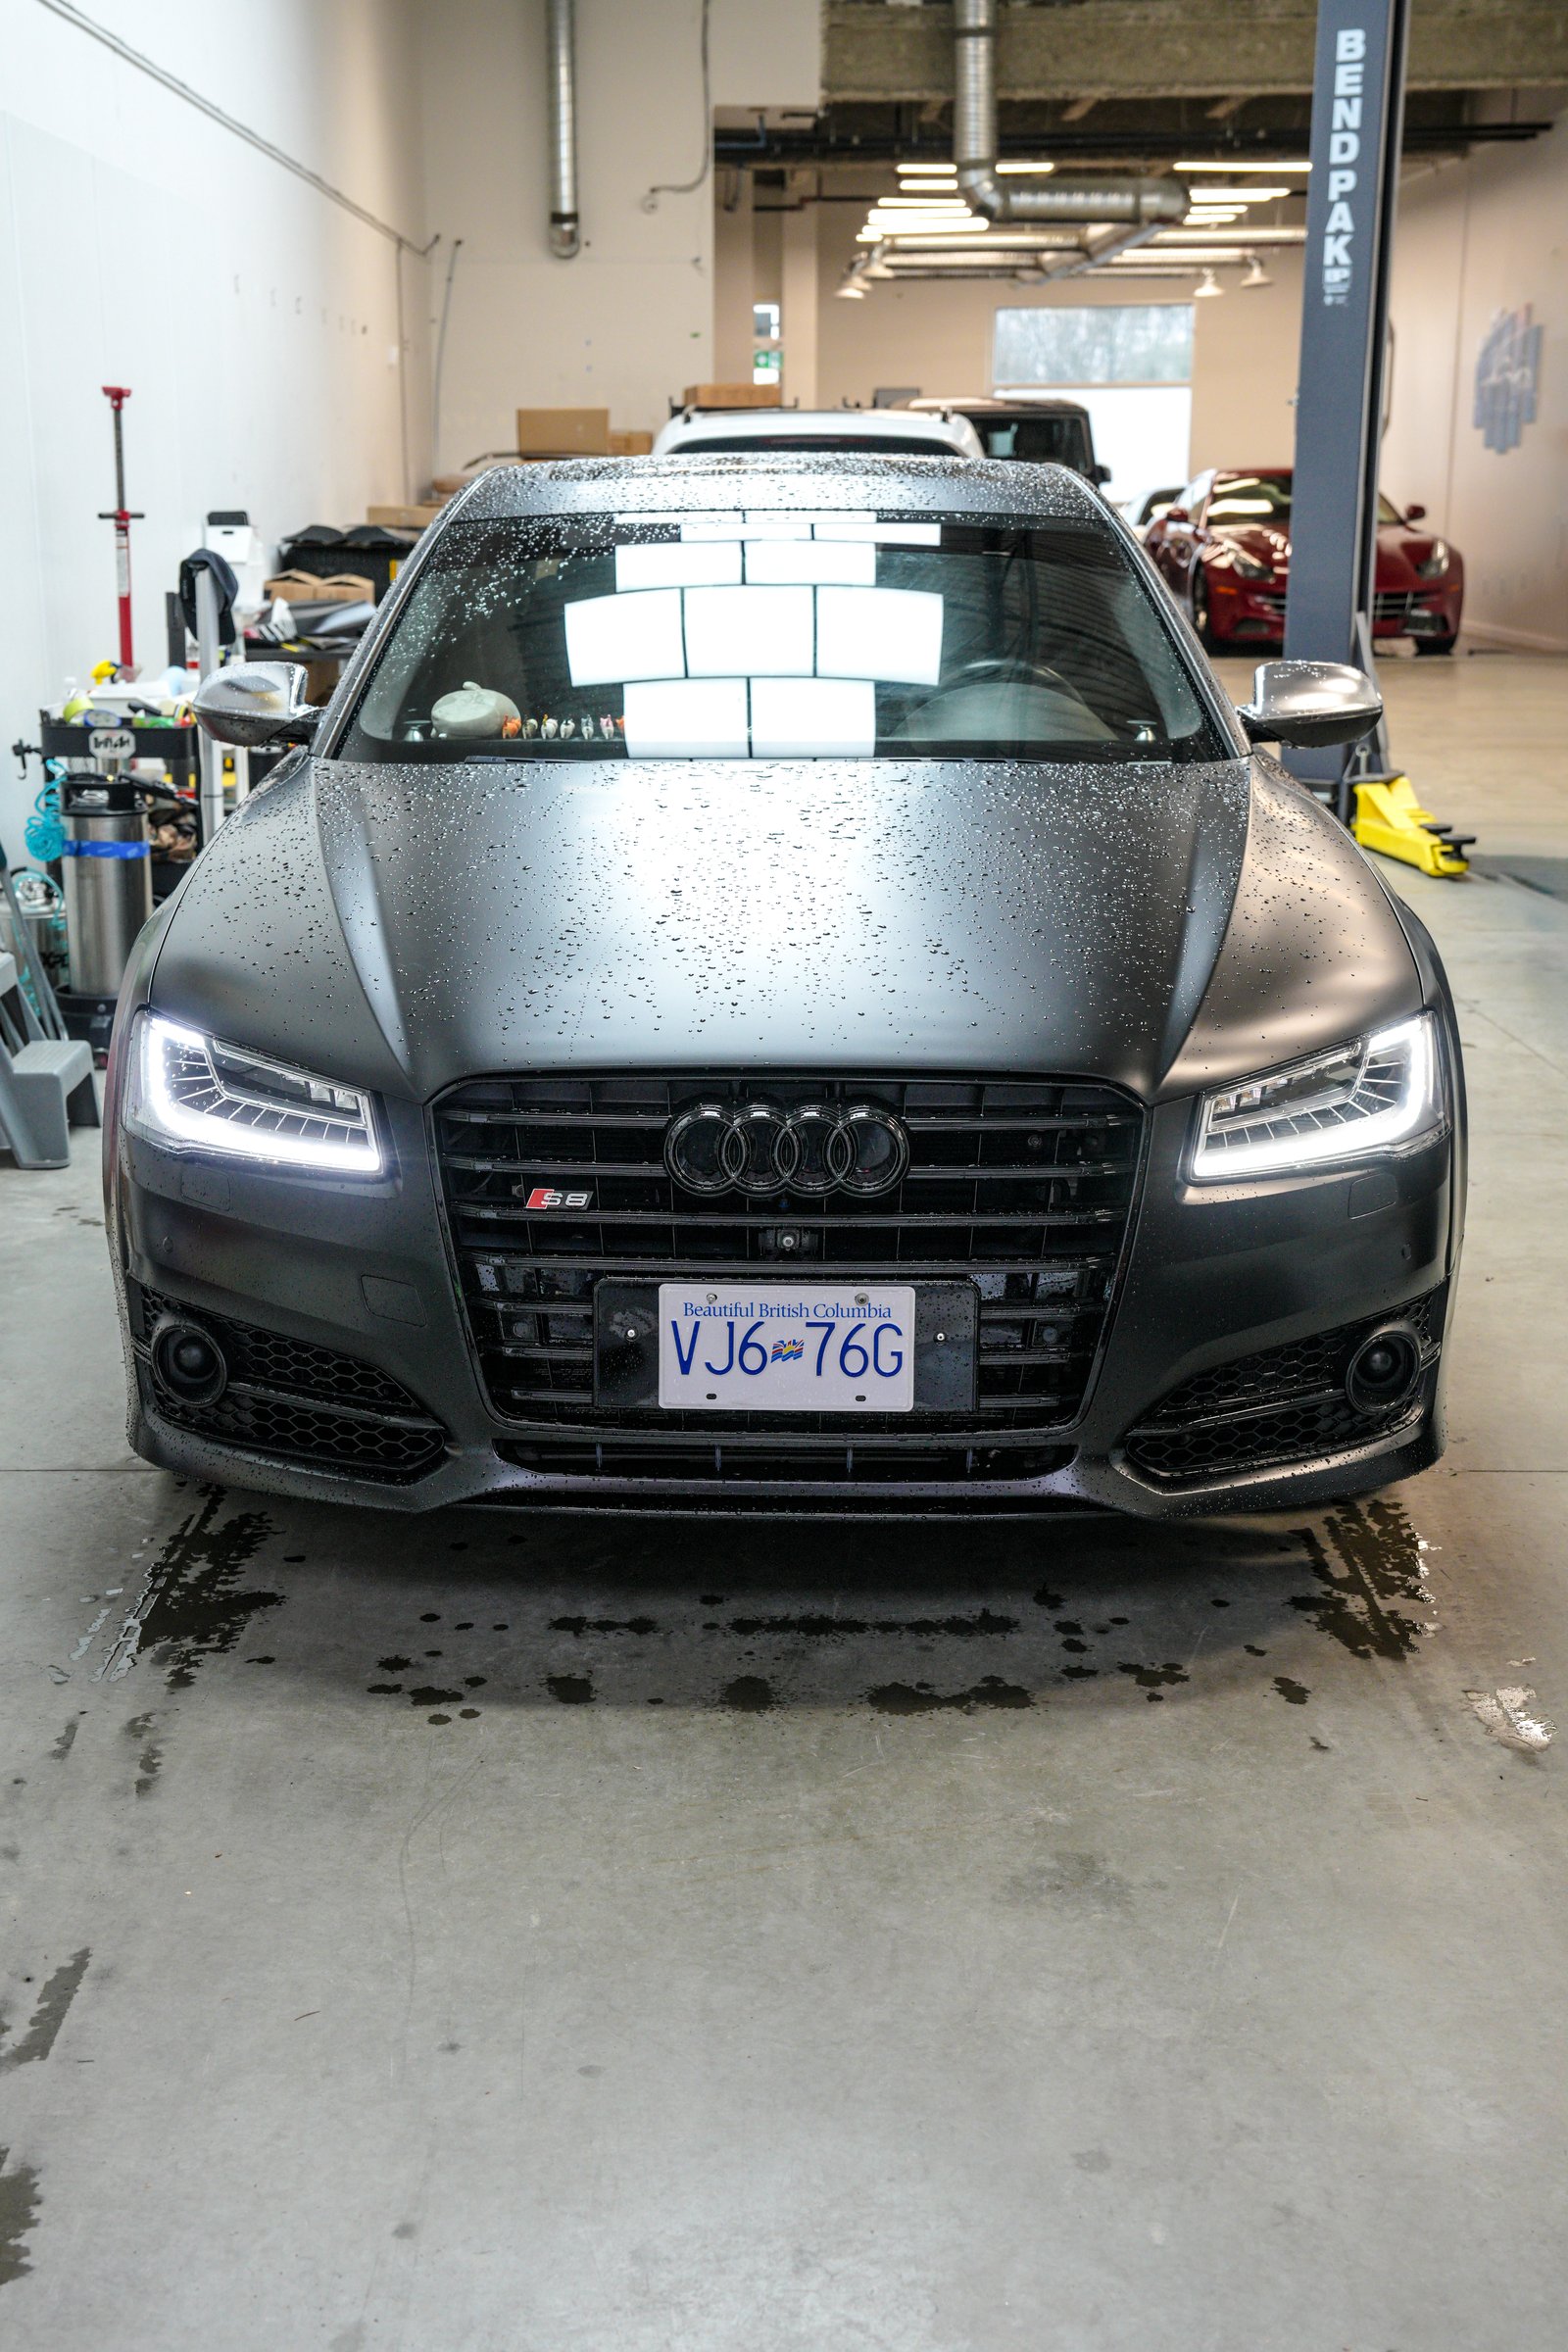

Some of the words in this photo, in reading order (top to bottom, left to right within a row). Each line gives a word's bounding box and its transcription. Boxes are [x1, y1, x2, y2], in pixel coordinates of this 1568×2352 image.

[1323, 28, 1366, 267] BENDPAK
[541, 1192, 588, 1206] S8
[684, 1301, 755, 1318] Beautiful
[759, 1303, 809, 1318] British
[813, 1304, 892, 1319] Columbia
[671, 1320, 768, 1375] VJ6
[805, 1322, 904, 1377] 76G
